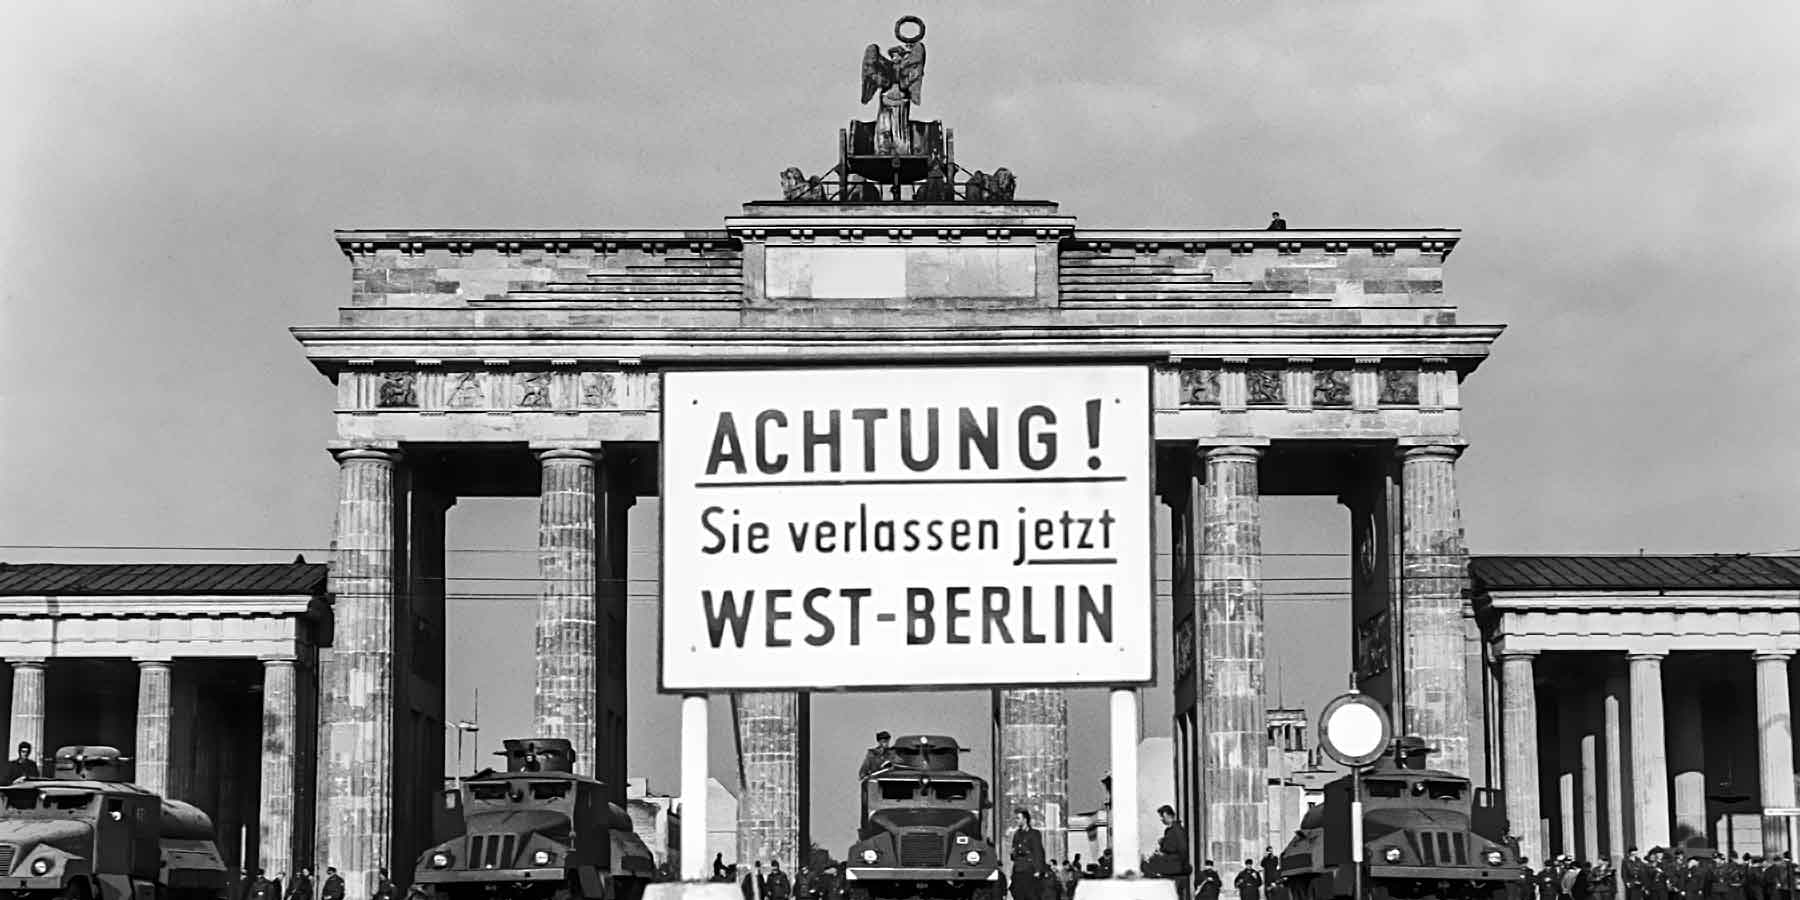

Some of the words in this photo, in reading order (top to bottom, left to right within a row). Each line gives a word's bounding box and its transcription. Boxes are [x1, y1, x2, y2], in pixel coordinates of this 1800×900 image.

[701, 506, 770, 555] Sie
[788, 503, 999, 554] verlassen
[1013, 507, 1116, 566] jetzt
[701, 584, 1113, 649] WEST-BERLIN
